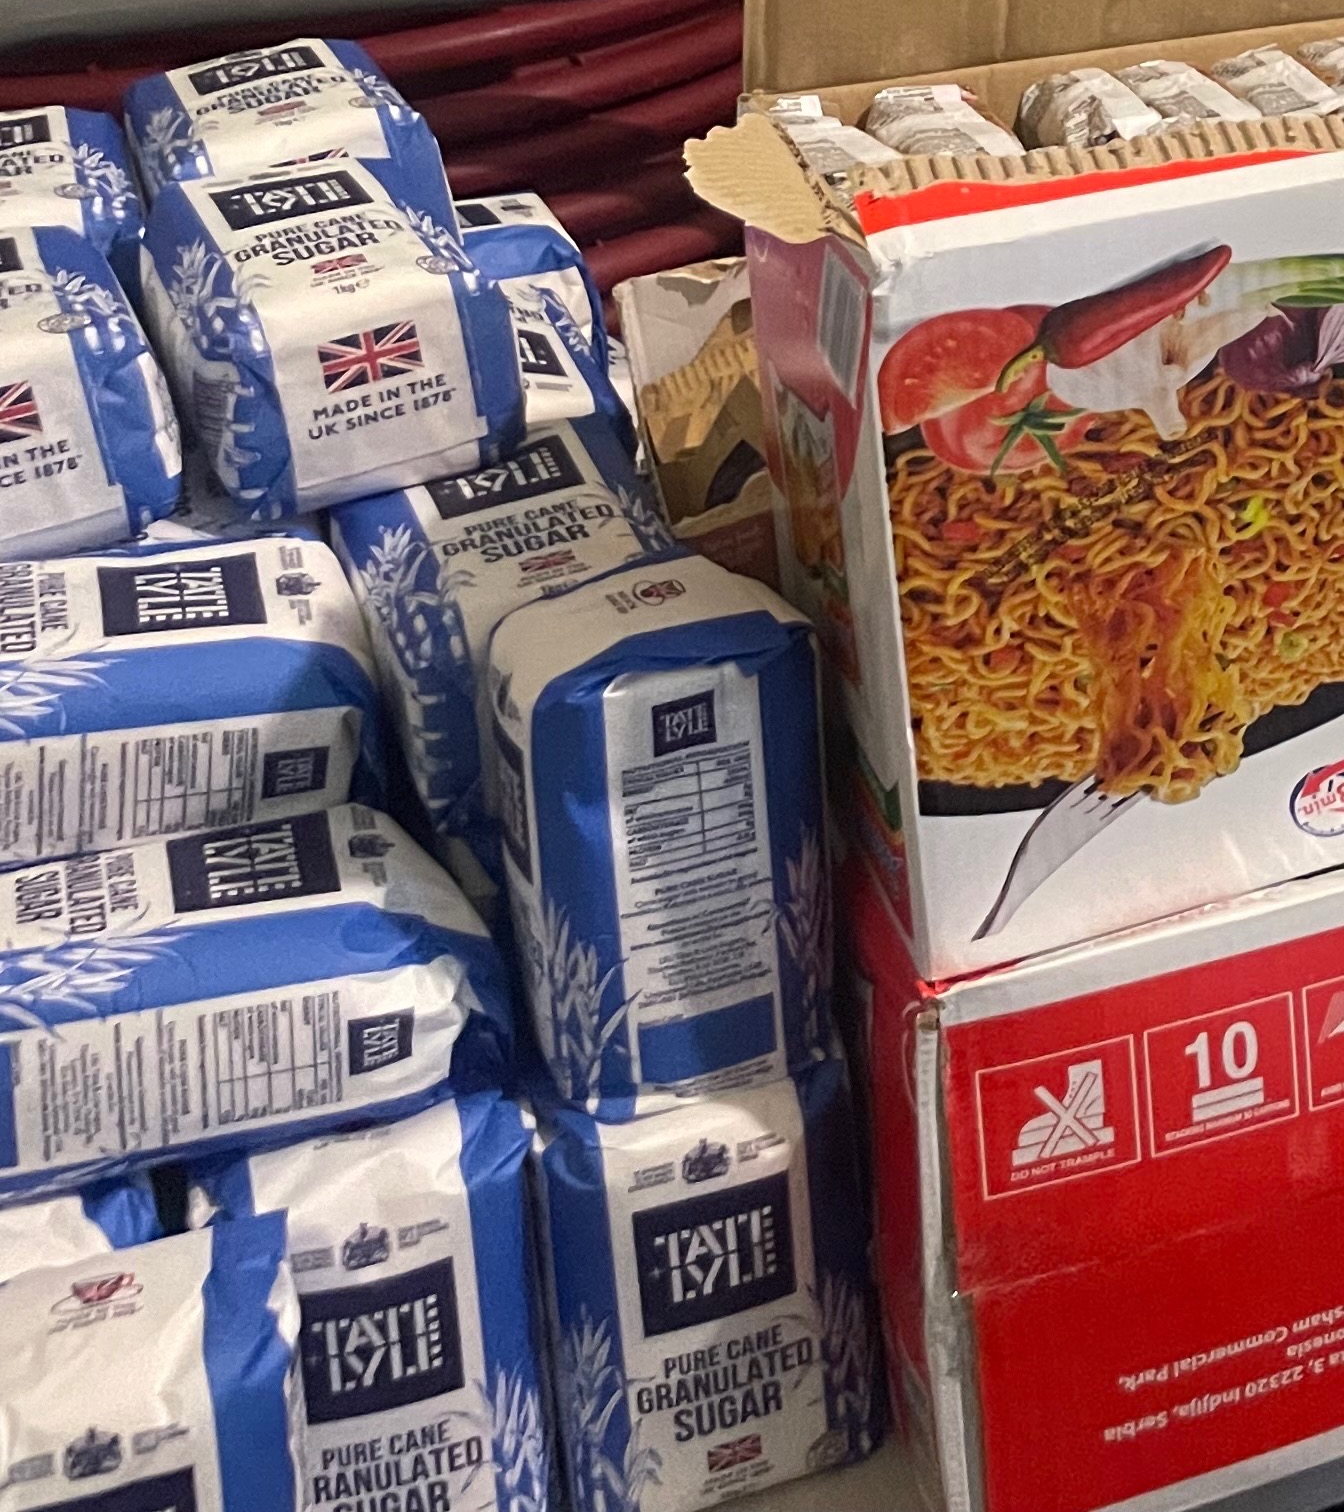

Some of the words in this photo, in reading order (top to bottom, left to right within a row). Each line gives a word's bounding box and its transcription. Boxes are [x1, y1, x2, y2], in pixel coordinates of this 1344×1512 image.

[233, 219, 404, 263] GRANULATED
[255, 223, 306, 243] PURE
[272, 233, 380, 266] SUGAR
[308, 423, 340, 440] UK
[346, 404, 405, 430] SINCE
[313, 393, 371, 421] MADE
[380, 388, 400, 403] IN
[407, 374, 446, 394] THE
[25, 439, 70, 461] THE
[442, 504, 614, 557] GRANULATED
[481, 523, 590, 563] SUGAR
[0, 561, 38, 653] GRANULATED
[40, 599, 69, 631] CANE
[135, 572, 178, 622] LYLE
[179, 566, 229, 619] TATE
[202, 838, 253, 899] LYLE
[251, 823, 302, 893] TATE
[15, 871, 63, 925] SUGAR
[109, 879, 139, 913] CANE
[1185, 1021, 1258, 1089] 10
[1010, 1168, 1029, 1182] DO
[1031, 1162, 1056, 1177] NOT
[1060, 1148, 1115, 1170] TRAMPLE
[654, 1205, 776, 1268] TATE
[670, 1241, 778, 1304] LYLE
[312, 1294, 440, 1355] TATE
[329, 1331, 443, 1392] LYLE
[636, 1335, 813, 1414] GRANULATED
[663, 1348, 721, 1378] PURE
[726, 1323, 783, 1357] CANE
[1173, 1326, 1288, 1377] Commercial
[1118, 1364, 1169, 1391] Park,
[1245, 1366, 1304, 1399] 22320
[674, 1380, 783, 1443] SUGAR
[1104, 1411, 1168, 1442] Serbia
[322, 1438, 382, 1469] PURE
[390, 1419, 451, 1455] CANE
[313, 1436, 483, 1504] RANULATED
